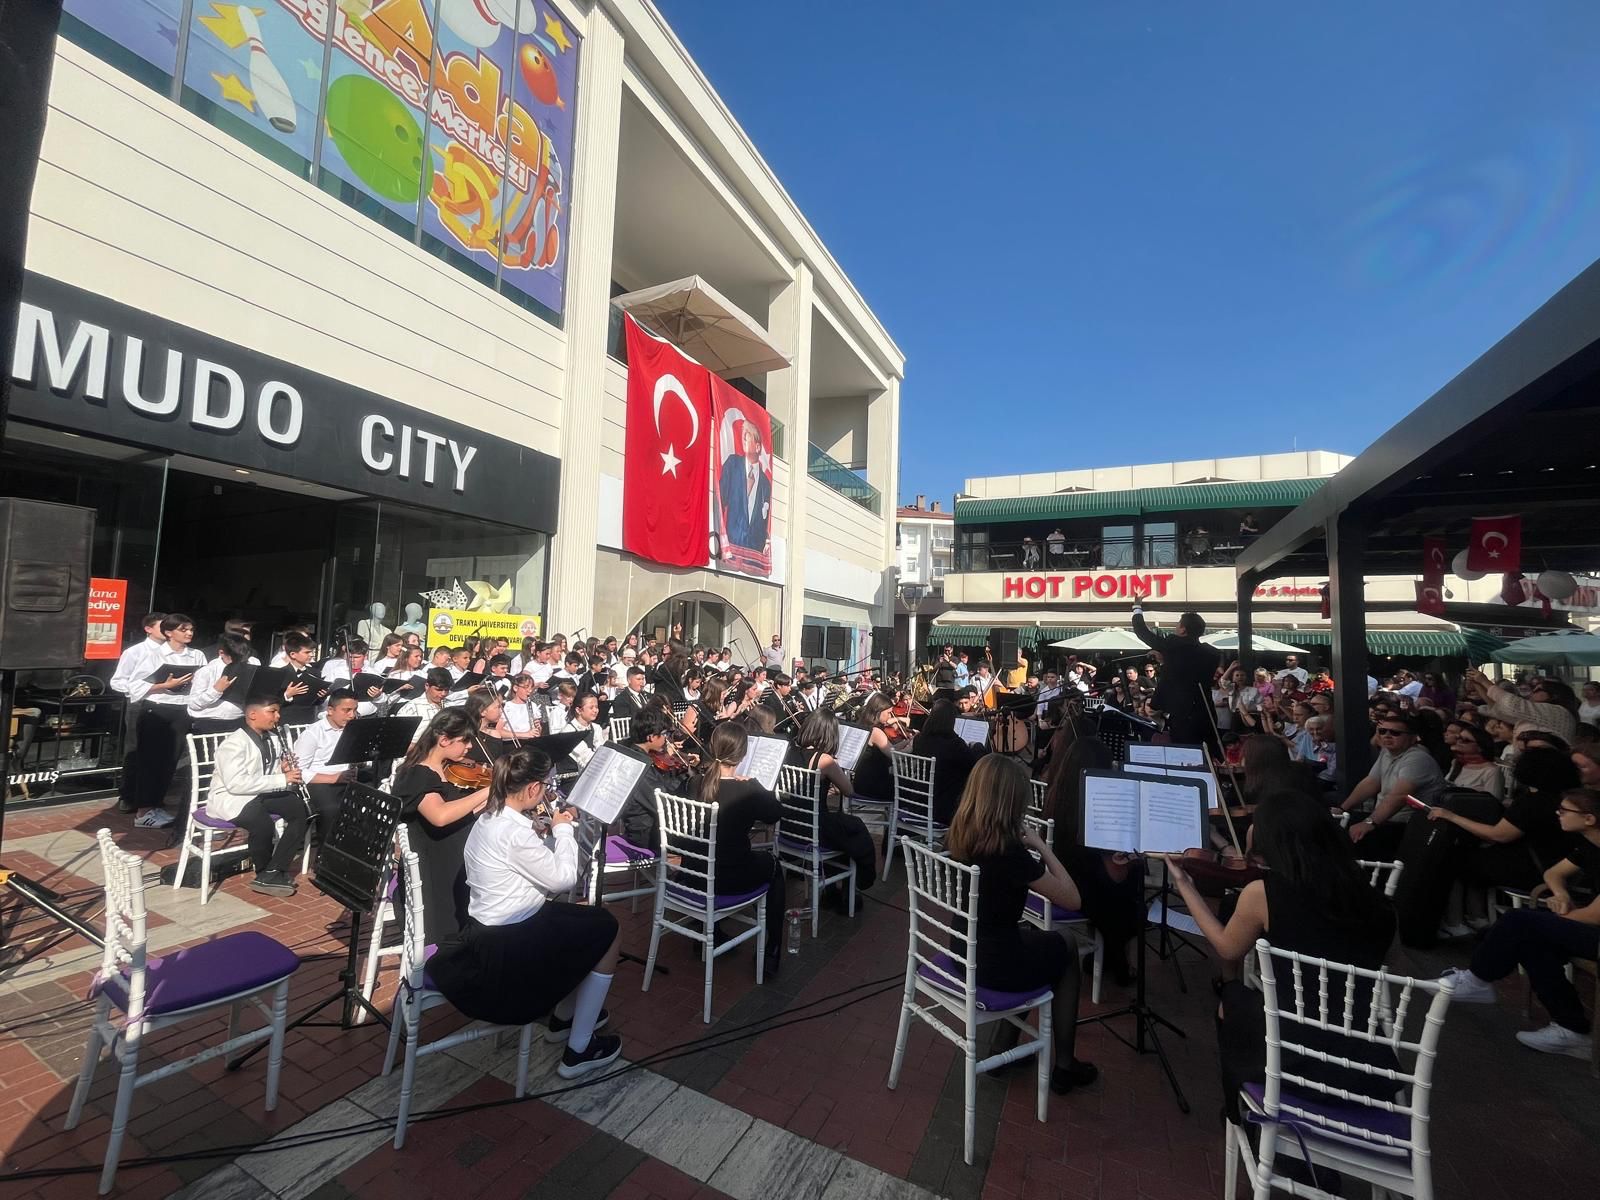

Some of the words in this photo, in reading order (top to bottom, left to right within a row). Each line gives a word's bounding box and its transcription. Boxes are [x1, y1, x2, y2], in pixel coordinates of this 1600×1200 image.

[431, 90, 528, 186] Merkezi
[12, 301, 304, 445] MUDO
[361, 414, 478, 492] CITY
[88, 587, 118, 599] lana
[1004, 576, 1065, 599] HOT
[1074, 574, 1174, 599] POINT
[87, 600, 121, 612] ediye
[456, 618, 478, 628] TRAKYA
[6, 769, 60, 785] unuş
